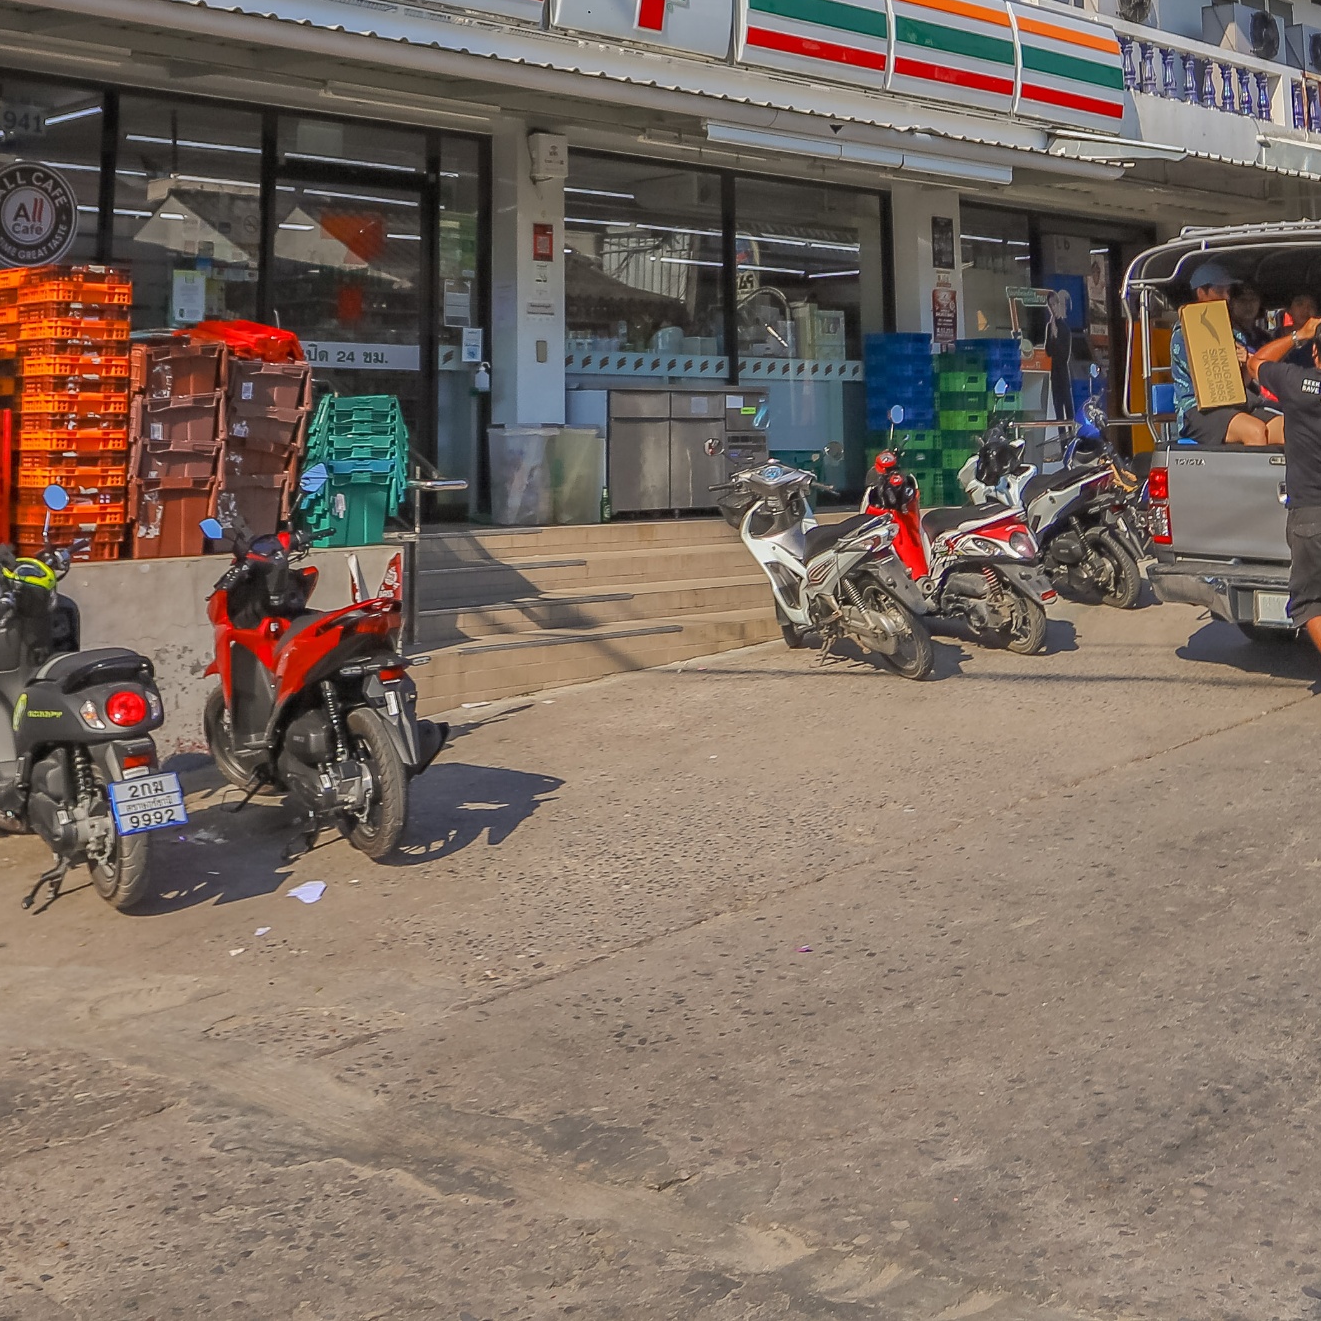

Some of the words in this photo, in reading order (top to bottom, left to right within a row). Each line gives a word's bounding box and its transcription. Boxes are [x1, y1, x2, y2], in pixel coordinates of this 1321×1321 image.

[13, 197, 44, 222] All
[17, 247, 48, 260] GREAT
[48, 223, 68, 254] TASTE
[336, 351, 355, 363] 24
[1201, 350, 1212, 378] TOKYO
[1218, 347, 1236, 402] KINUGAWA
[1174, 458, 1206, 466] TOYOTA
[129, 808, 176, 828] 9992
